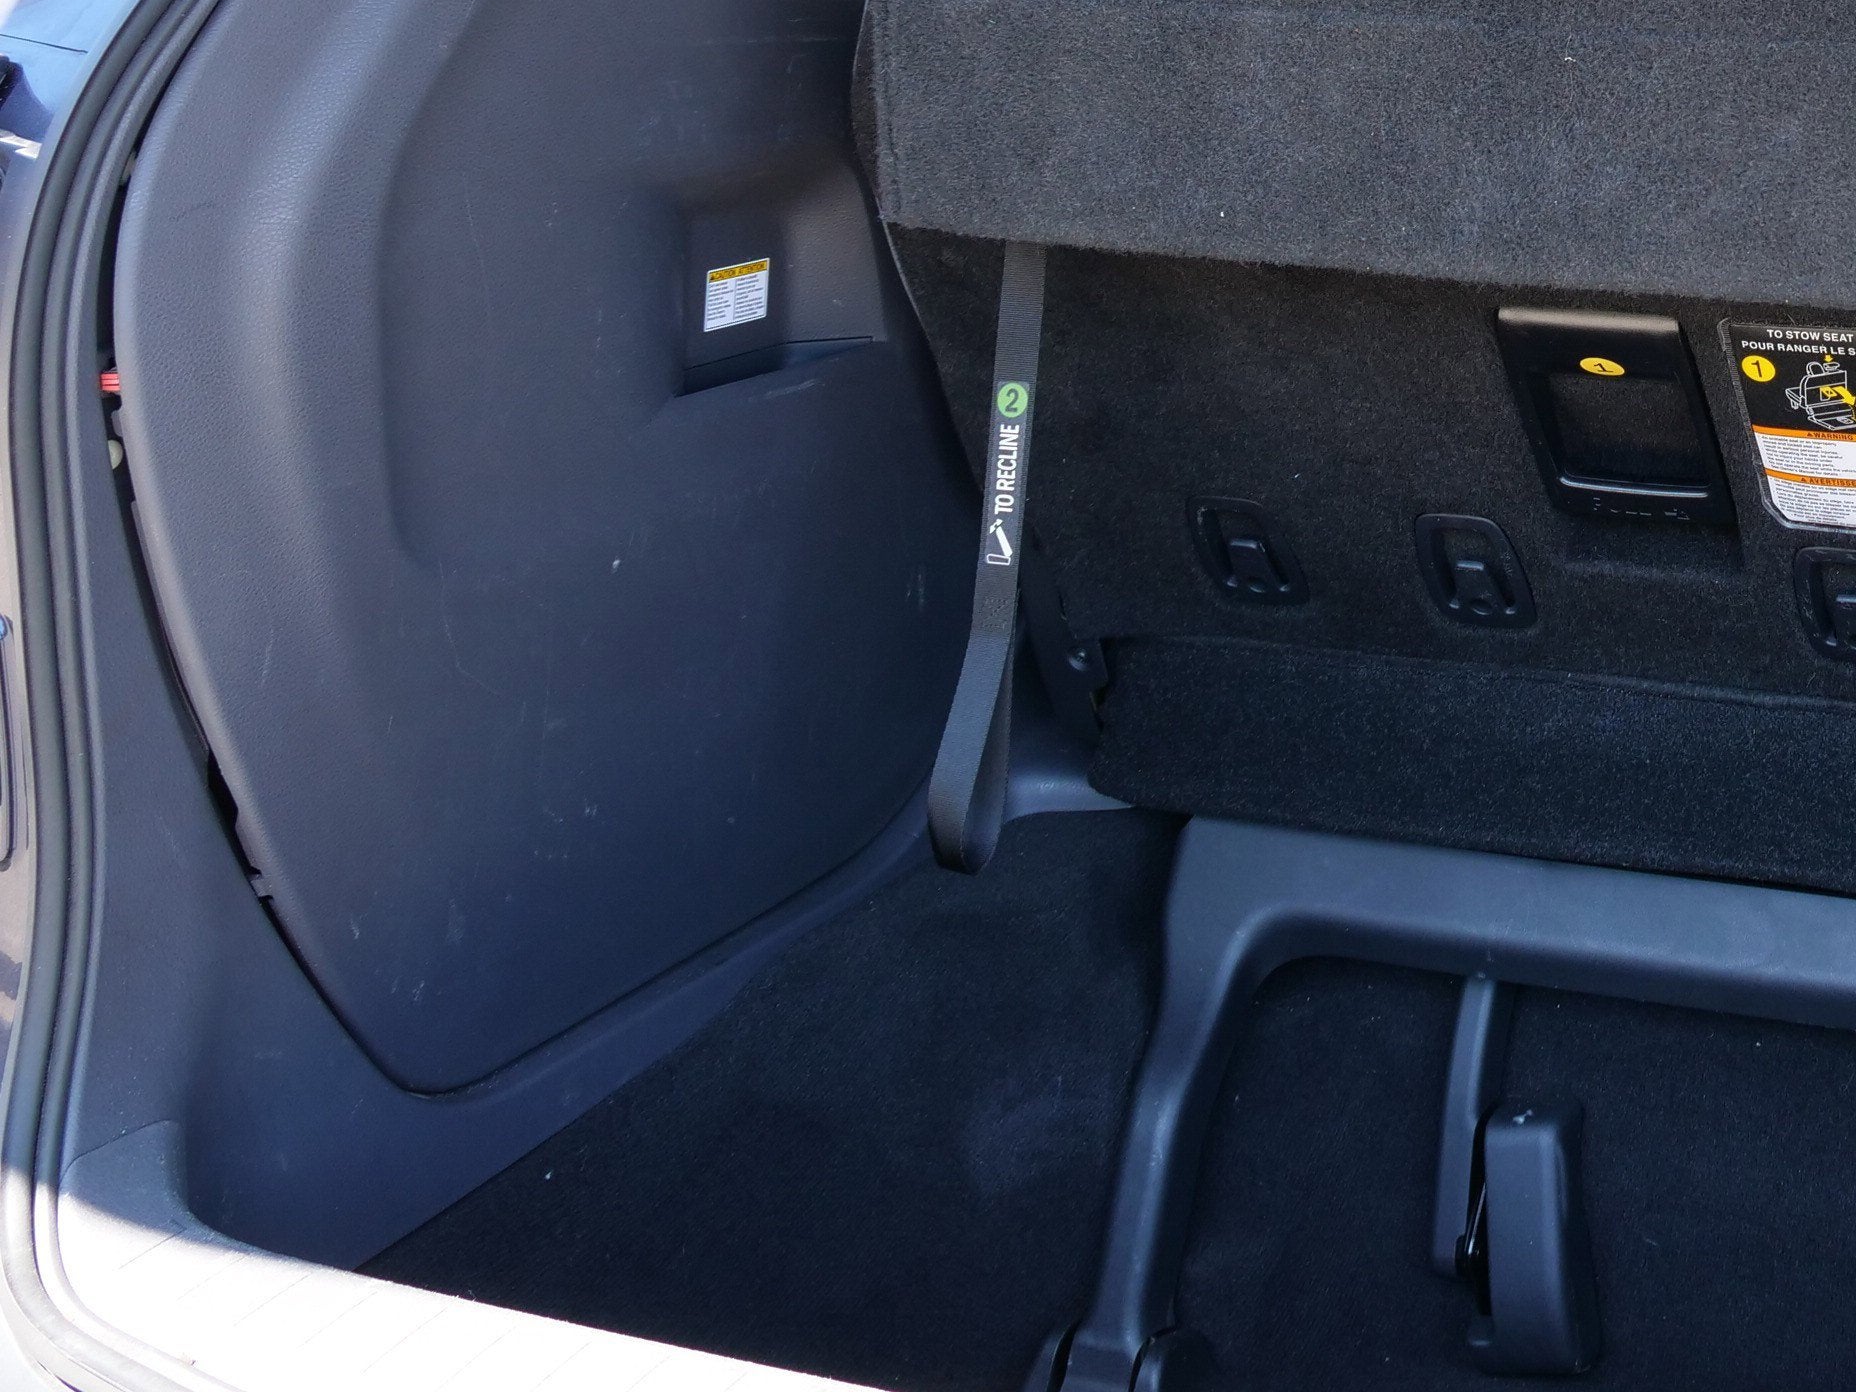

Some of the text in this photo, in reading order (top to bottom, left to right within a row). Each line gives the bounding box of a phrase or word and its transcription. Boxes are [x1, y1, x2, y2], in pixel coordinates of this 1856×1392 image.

[1766, 329, 1854, 342] TO STOW SEAT
[1742, 340, 1774, 350] POUR
[1778, 344, 1828, 354] RANGER
[1830, 346, 1846, 355] LE
[1594, 362, 1614, 373] 1
[1751, 360, 1763, 378] 1
[1004, 388, 1020, 413] 2
[1812, 432, 1854, 441] WARNING
[994, 424, 1020, 515] TO RECLINE
